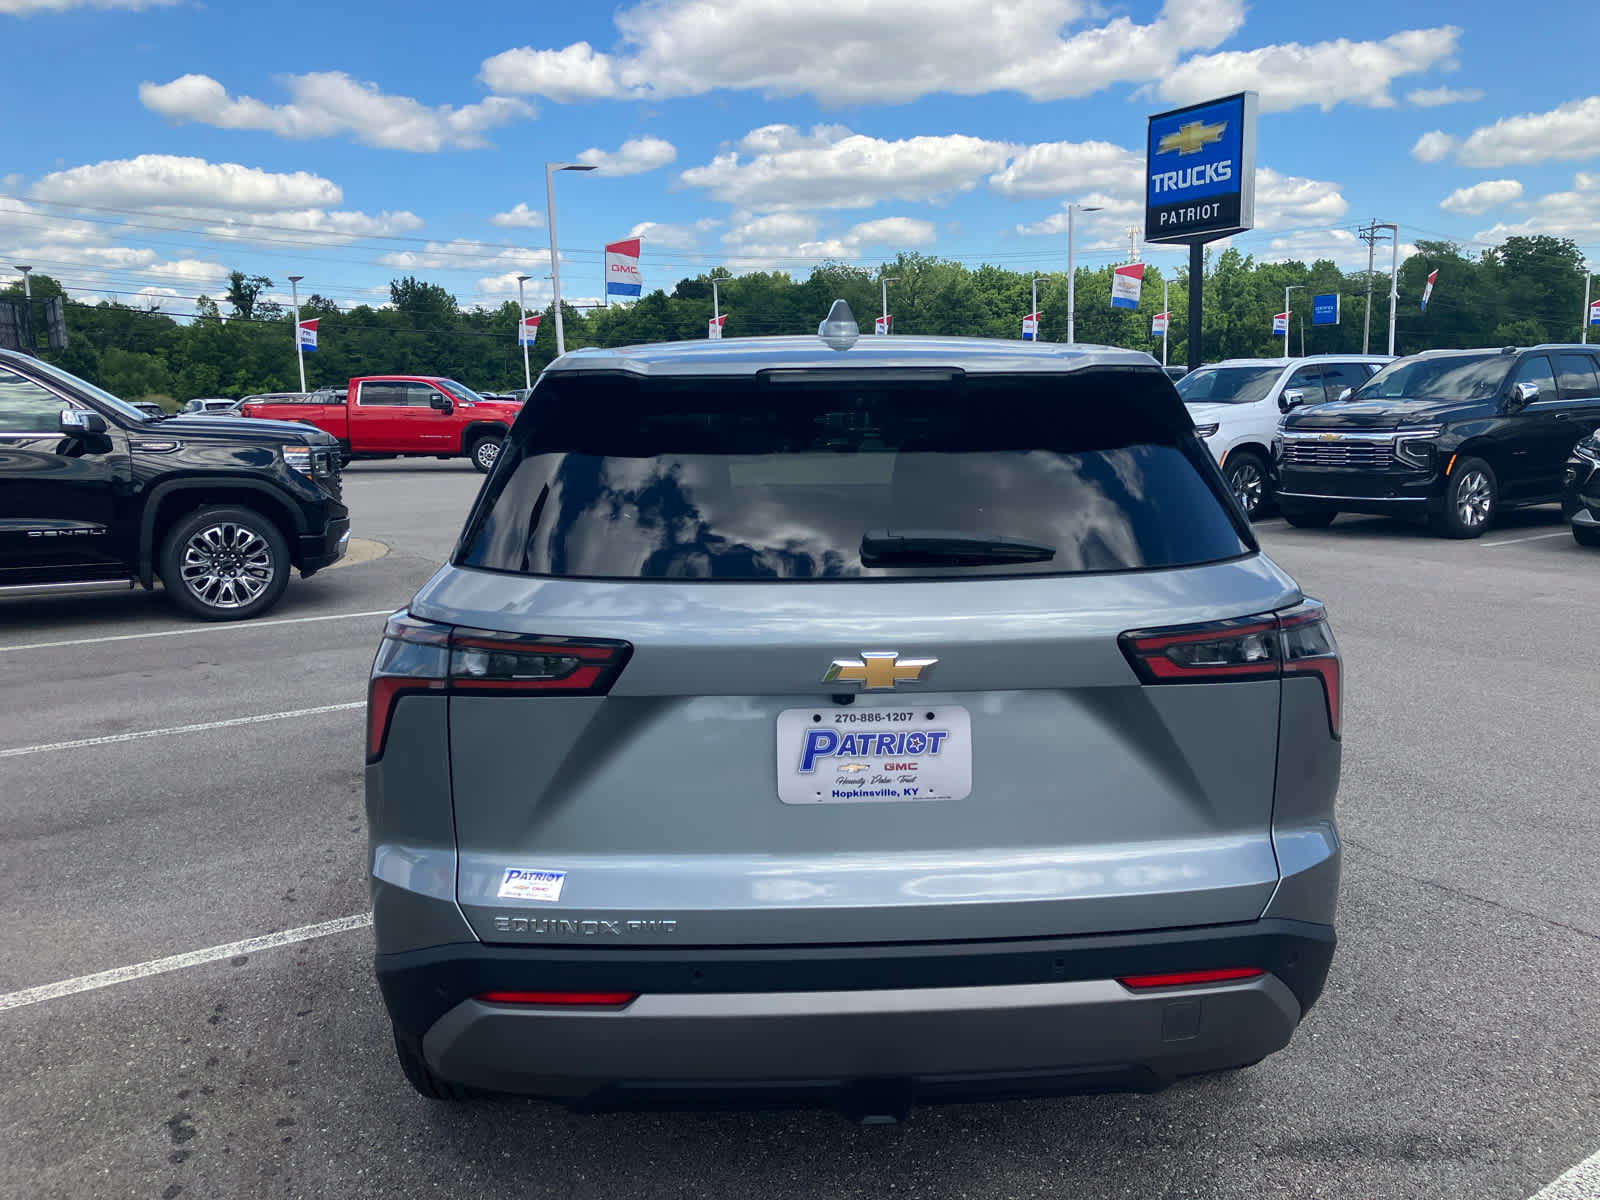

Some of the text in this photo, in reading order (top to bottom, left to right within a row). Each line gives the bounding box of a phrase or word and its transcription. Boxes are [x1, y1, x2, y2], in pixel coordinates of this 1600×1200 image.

[1152, 160, 1232, 193] TRUCKS
[1160, 203, 1220, 225] PATRIOT
[611, 264, 638, 274] GMC
[835, 712, 914, 723] 270-886-1207
[799, 728, 948, 774] PATRIOT
[884, 762, 918, 771] GMC
[832, 788, 919, 799] Hopkinsville, KY
[495, 917, 677, 935] EQUINOX FWD
